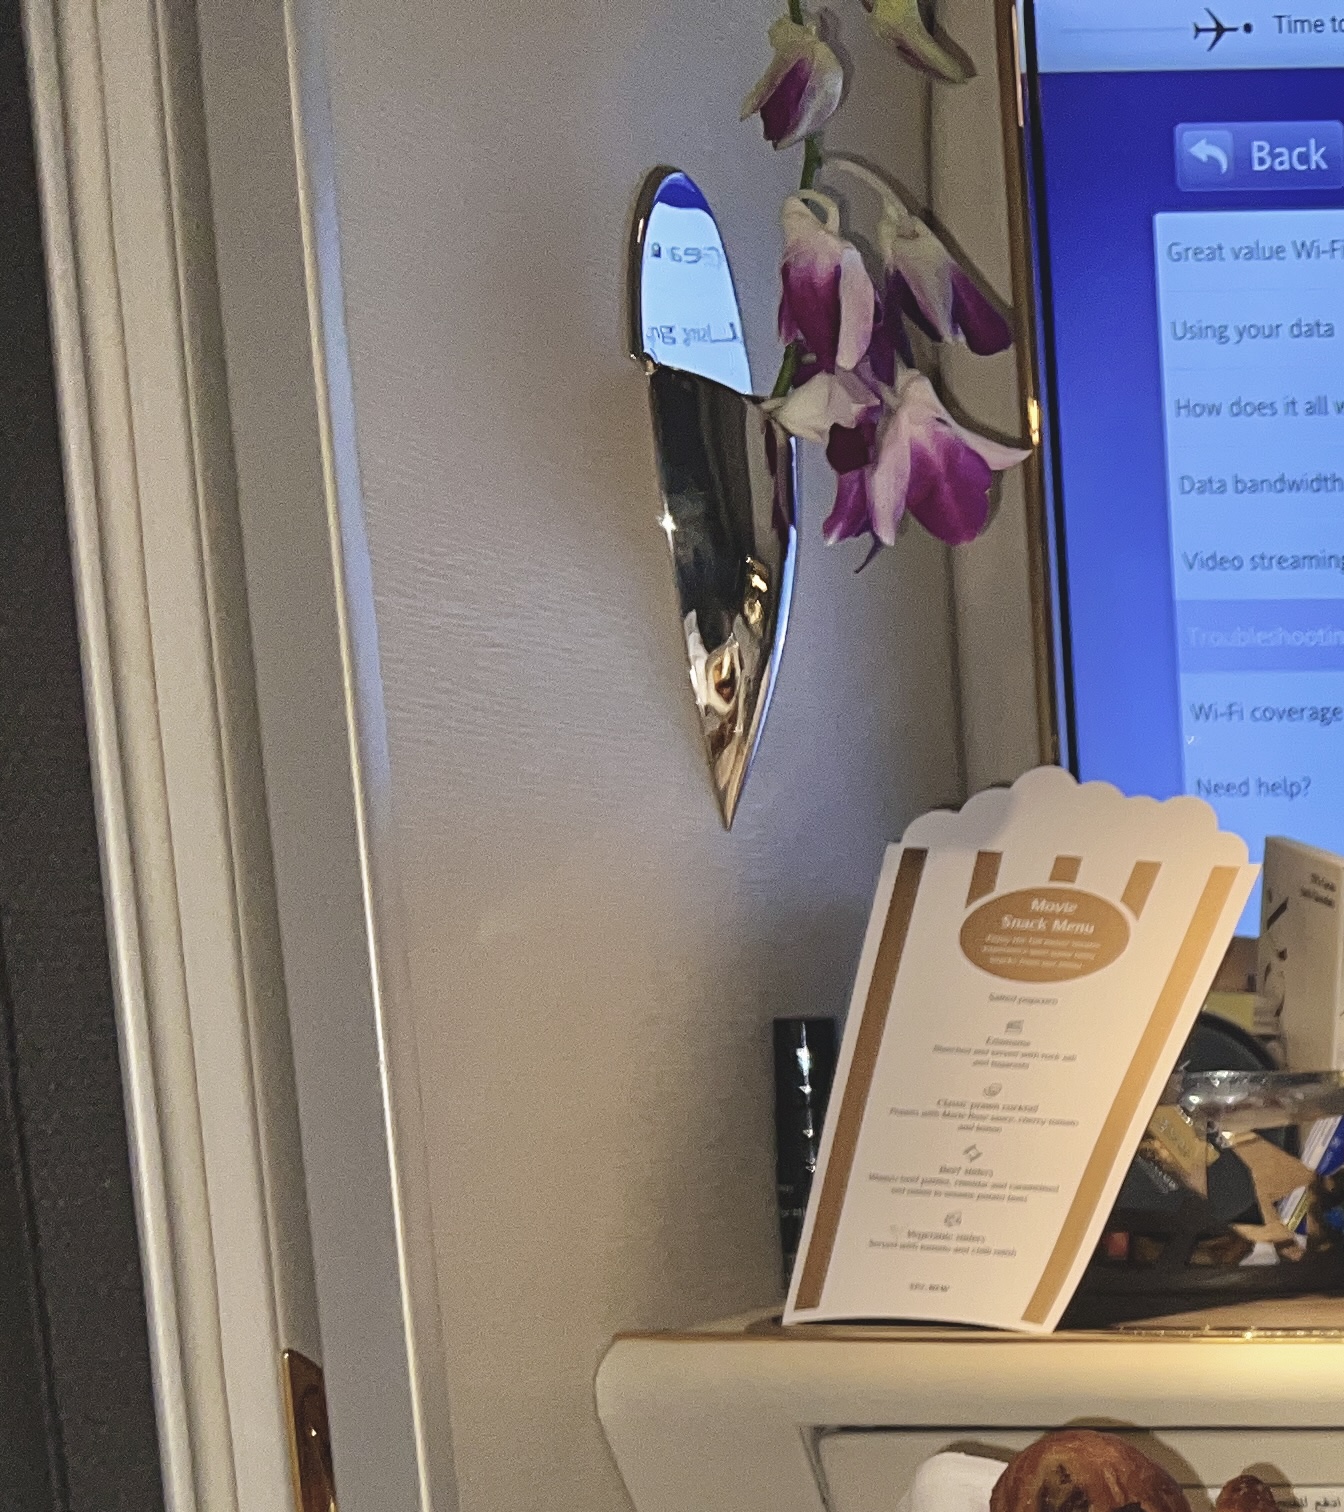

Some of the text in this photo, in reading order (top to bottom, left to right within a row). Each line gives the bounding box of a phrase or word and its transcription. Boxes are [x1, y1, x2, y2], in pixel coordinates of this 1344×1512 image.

[1272, 15, 1325, 34] Time
[1252, 138, 1328, 172] Back
[1166, 240, 1226, 262] Great
[1230, 239, 1287, 262] value
[1170, 317, 1336, 345] Using your data
[1174, 397, 1223, 419] How
[1227, 395, 1279, 418] does
[1283, 393, 1299, 417] it
[1304, 394, 1330, 417] all
[1180, 472, 1344, 496] Data bandwidth
[1181, 550, 1245, 572] Video
[1189, 701, 1344, 728] Wi-Fi coverage
[1196, 775, 1312, 801] Need help?
[1001, 914, 1096, 936] Snack Menu
